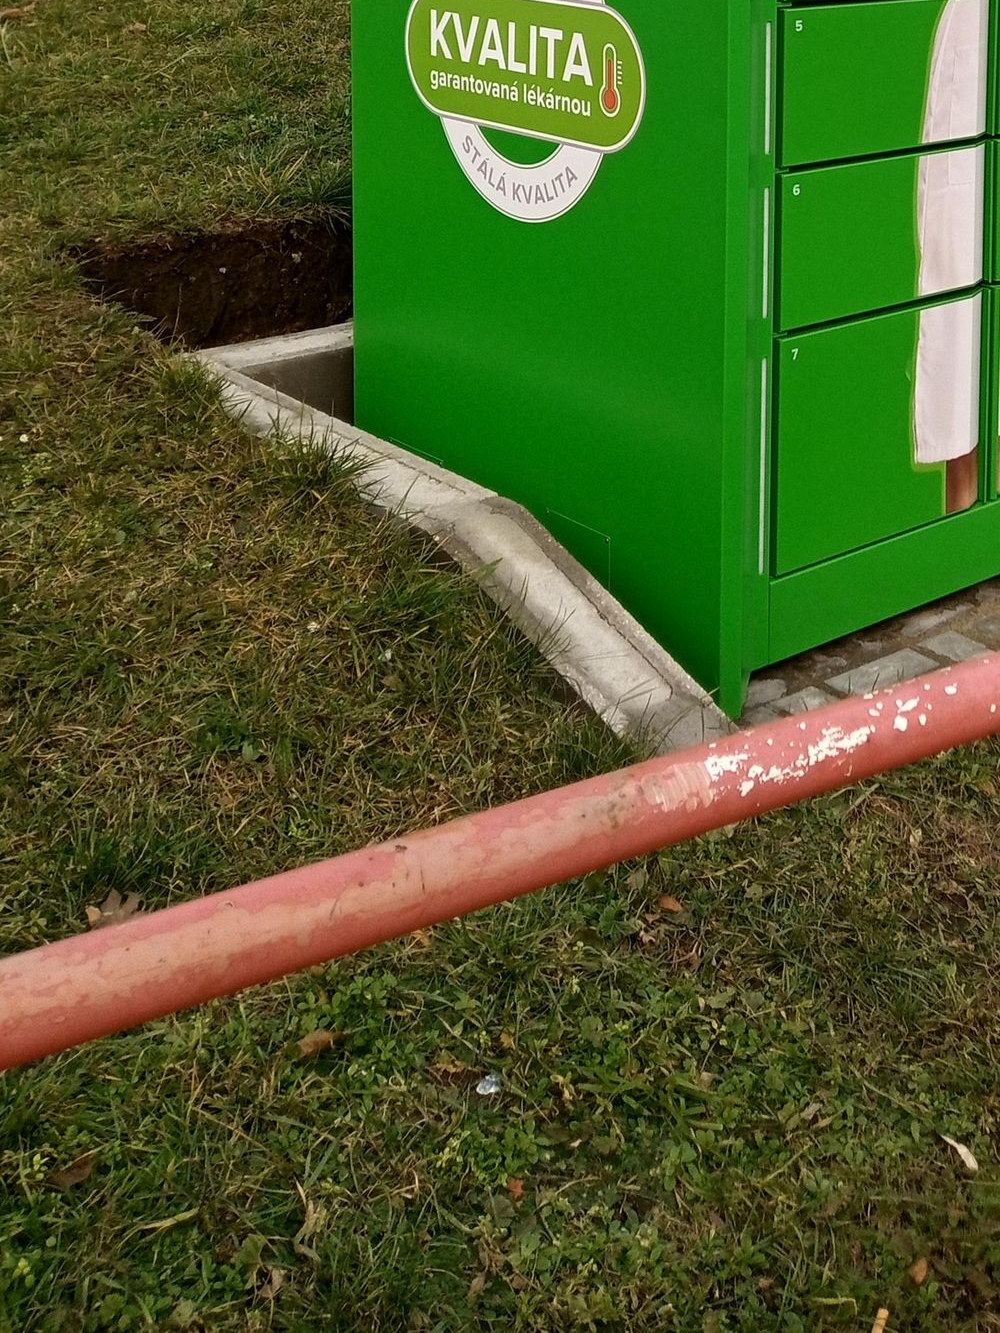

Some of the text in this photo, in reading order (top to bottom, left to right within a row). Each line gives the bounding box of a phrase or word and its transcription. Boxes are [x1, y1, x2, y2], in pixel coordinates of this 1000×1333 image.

[794, 18, 804, 32] 5
[430, 9, 593, 87] KVALITA
[430, 69, 591, 117] garantovaná lékárnou
[462, 135, 578, 205] STÁLÁ KVALITA
[792, 183, 801, 197] 6
[791, 347, 800, 361] 7
